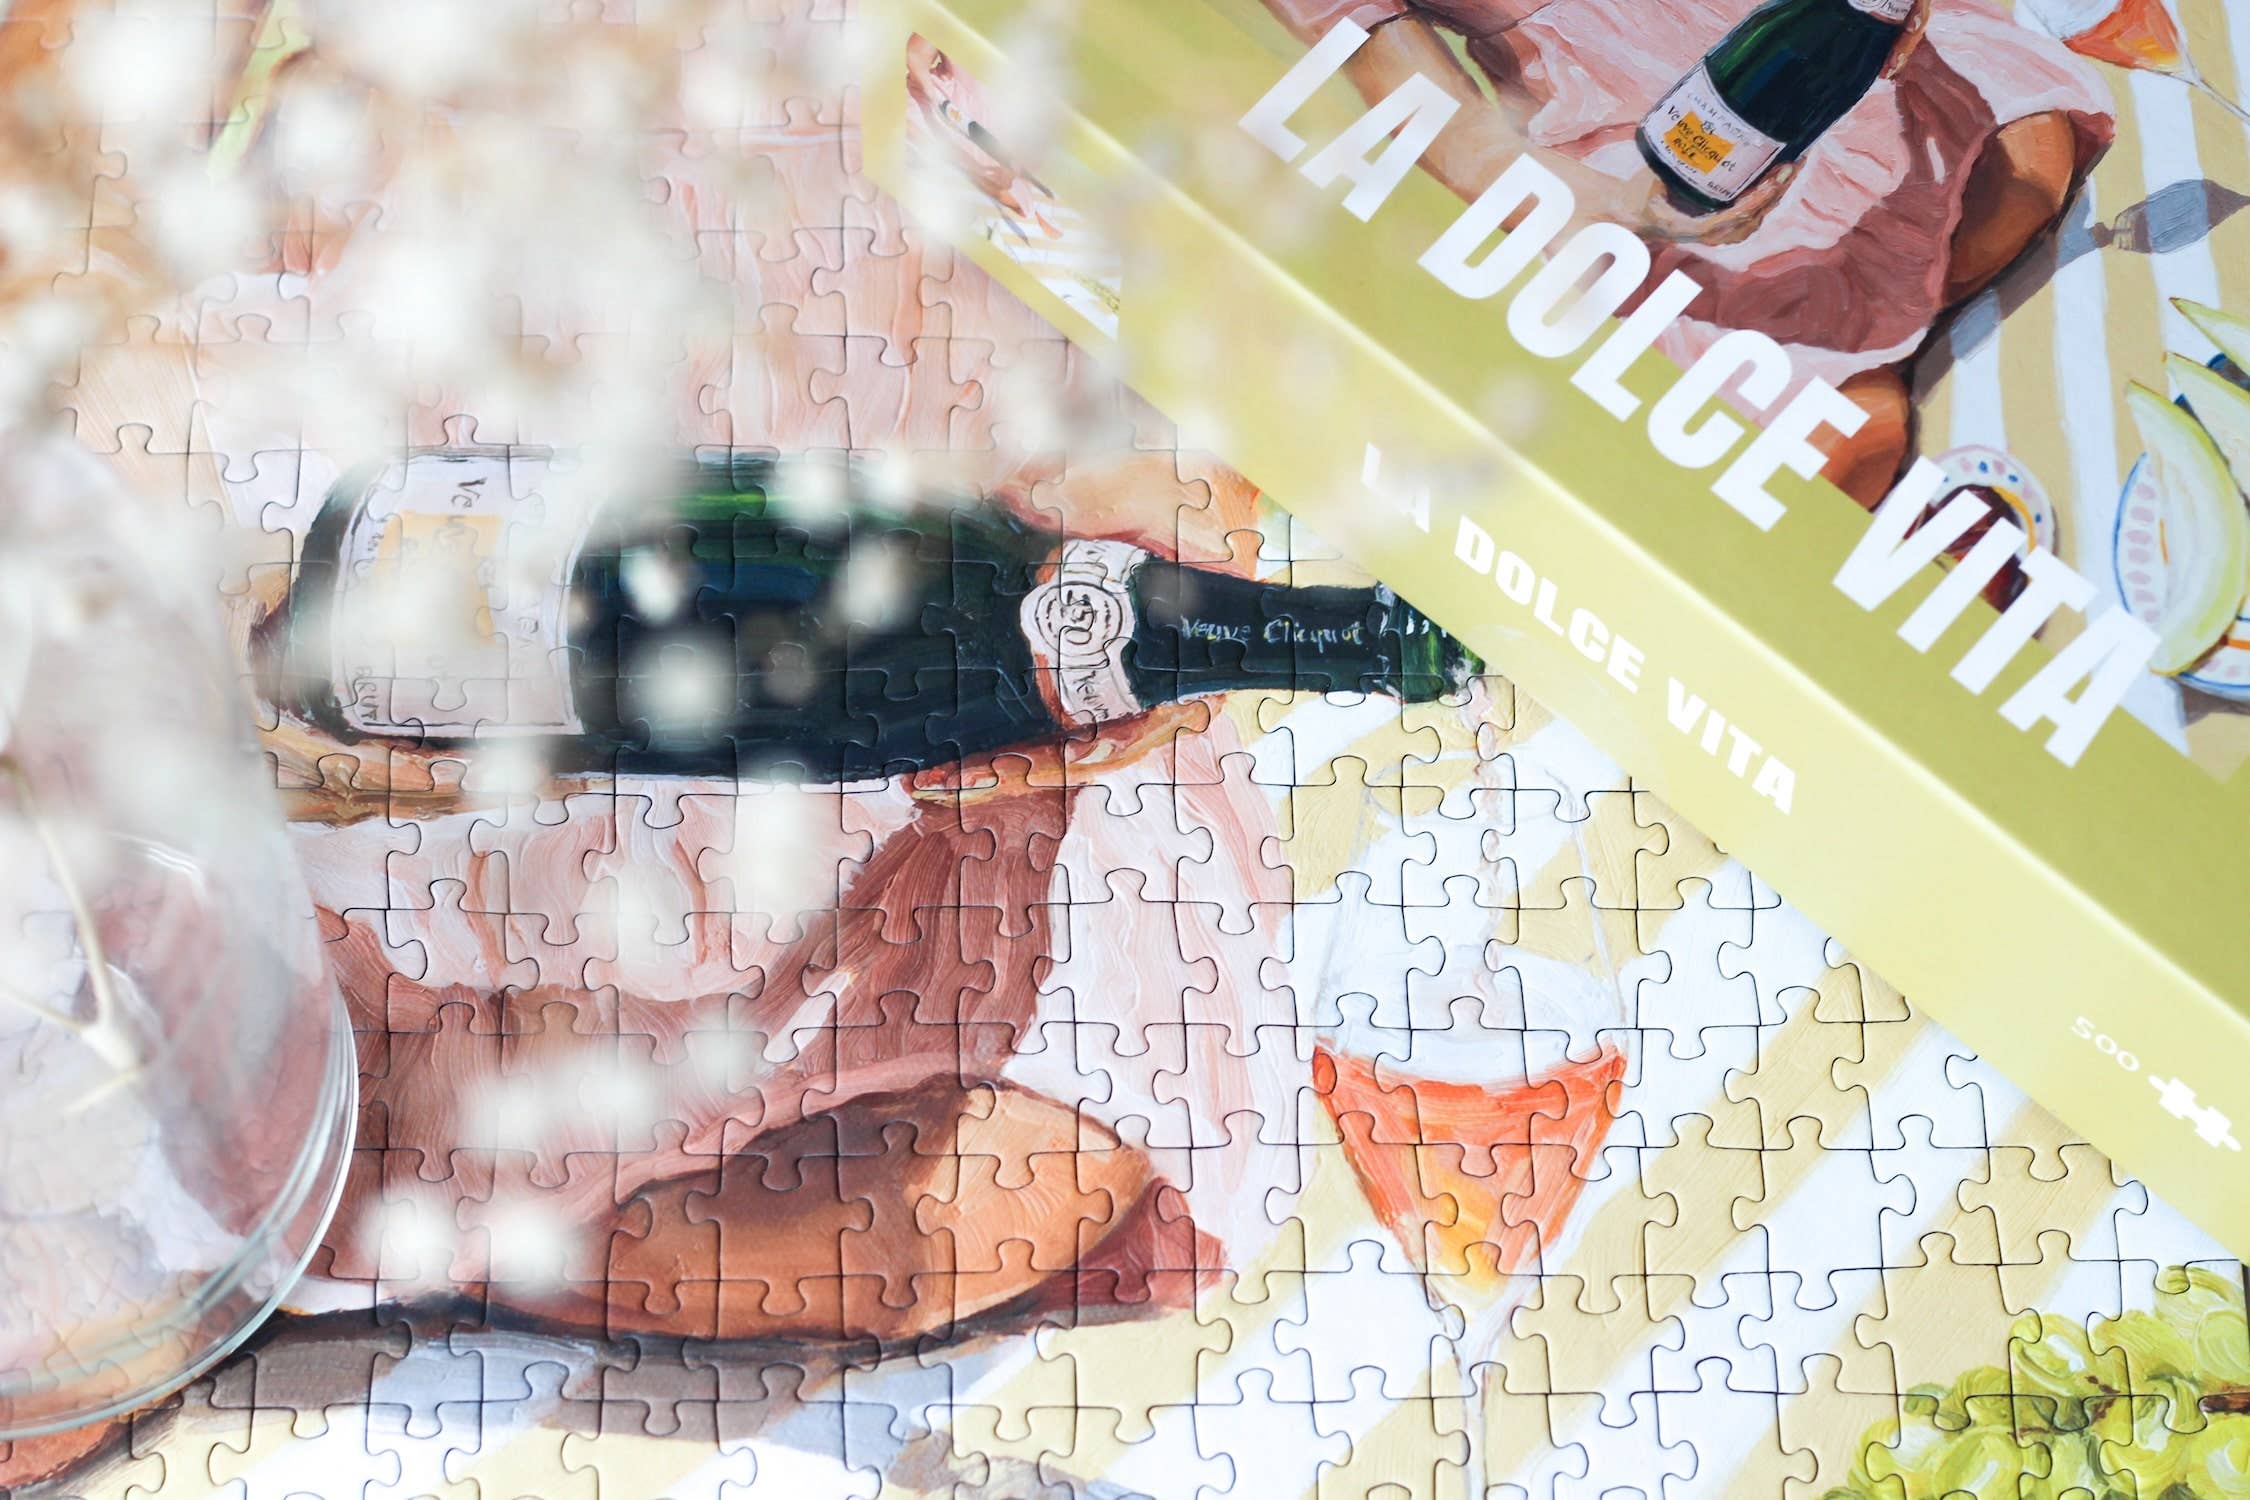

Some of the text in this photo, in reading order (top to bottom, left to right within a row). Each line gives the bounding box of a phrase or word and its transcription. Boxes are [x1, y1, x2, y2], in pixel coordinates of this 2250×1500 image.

[1238, 18, 2160, 767] LA DOLCE VITA
[1454, 515, 1645, 693] DOLCE
[1667, 677, 1796, 815] VITA
[2071, 1015, 2140, 1072] 500
